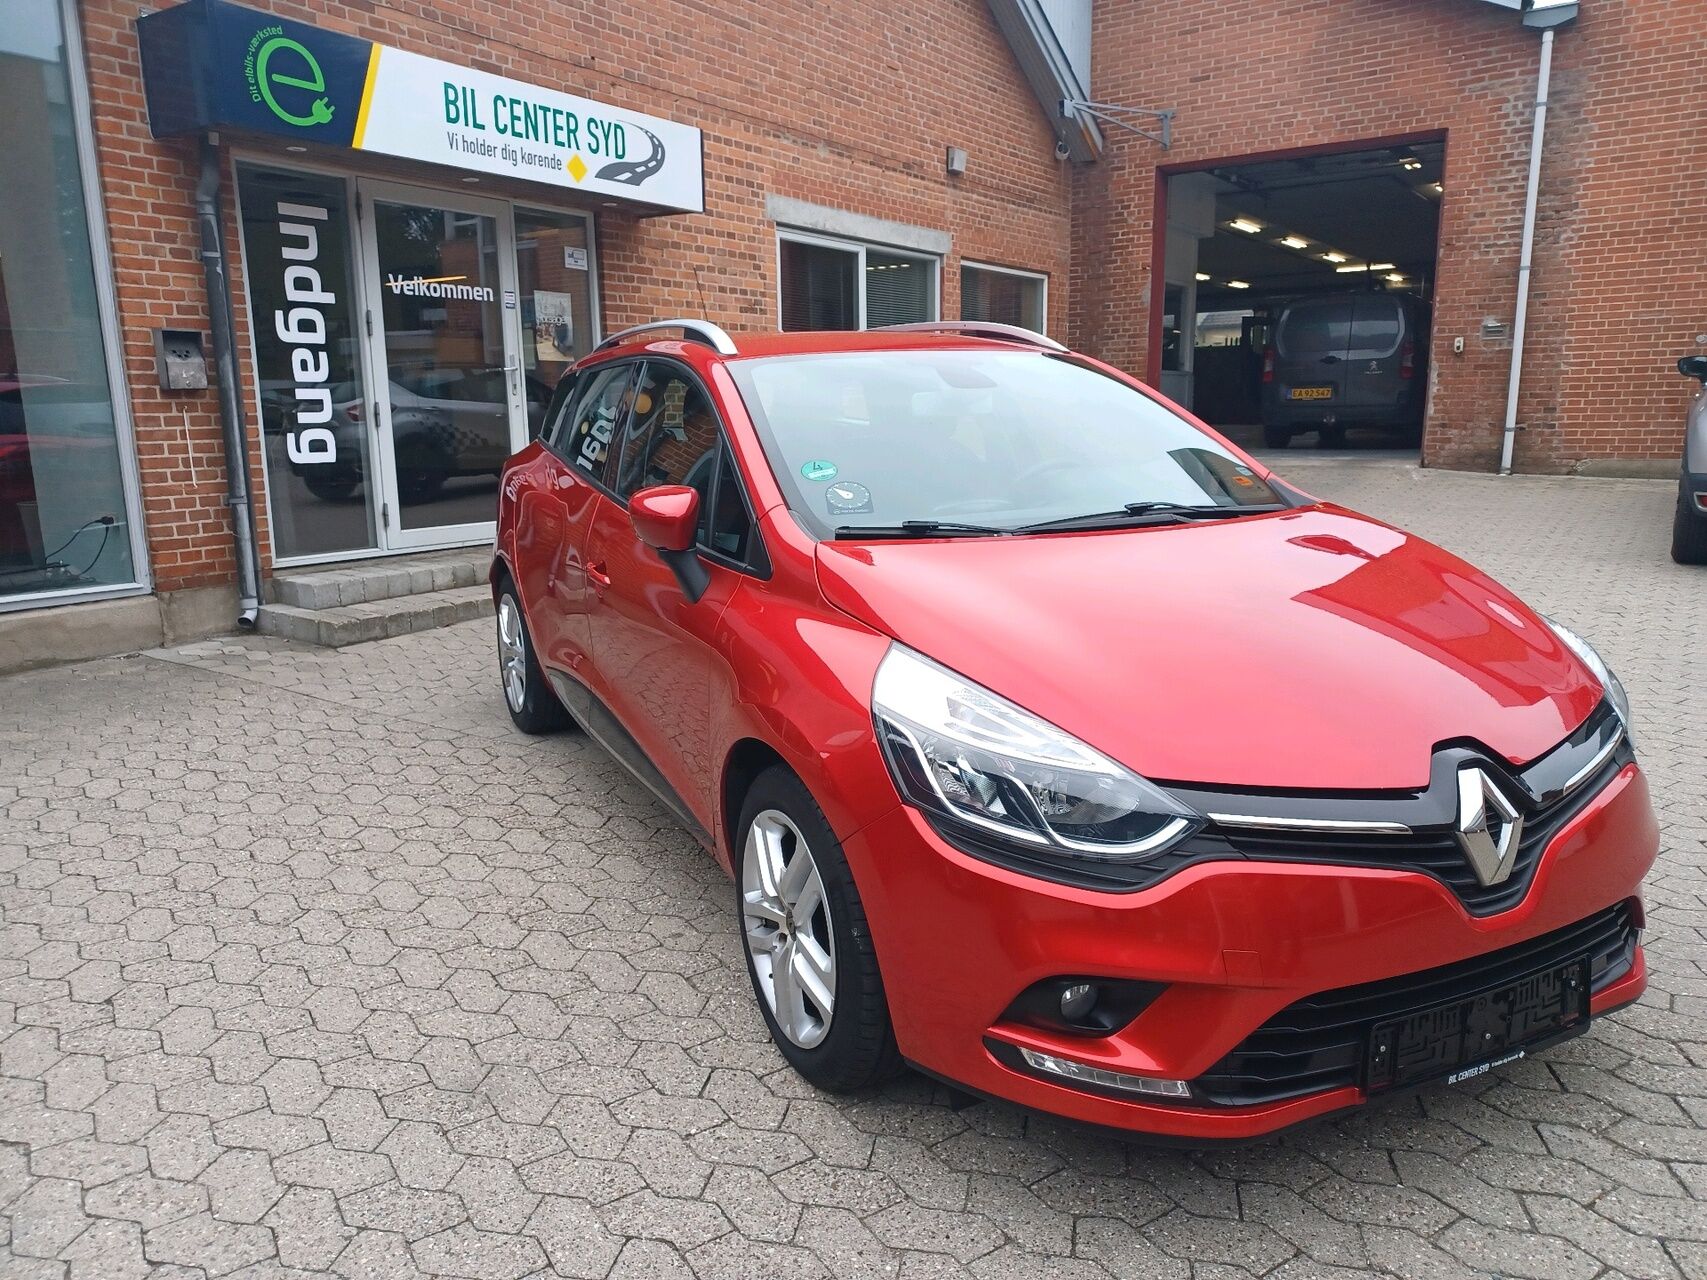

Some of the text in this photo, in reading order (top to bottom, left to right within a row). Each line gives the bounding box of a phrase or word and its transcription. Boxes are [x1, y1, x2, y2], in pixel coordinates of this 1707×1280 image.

[243, 25, 284, 102] Dit elbils-værksted
[443, 81, 626, 160] BIL CENTER SYD
[447, 131, 563, 171] Vi holder dig kørende
[387, 273, 495, 302] Velkommen
[275, 201, 337, 464] Indgang
[1448, 1063, 1490, 1084] BIL CENTER SYD
